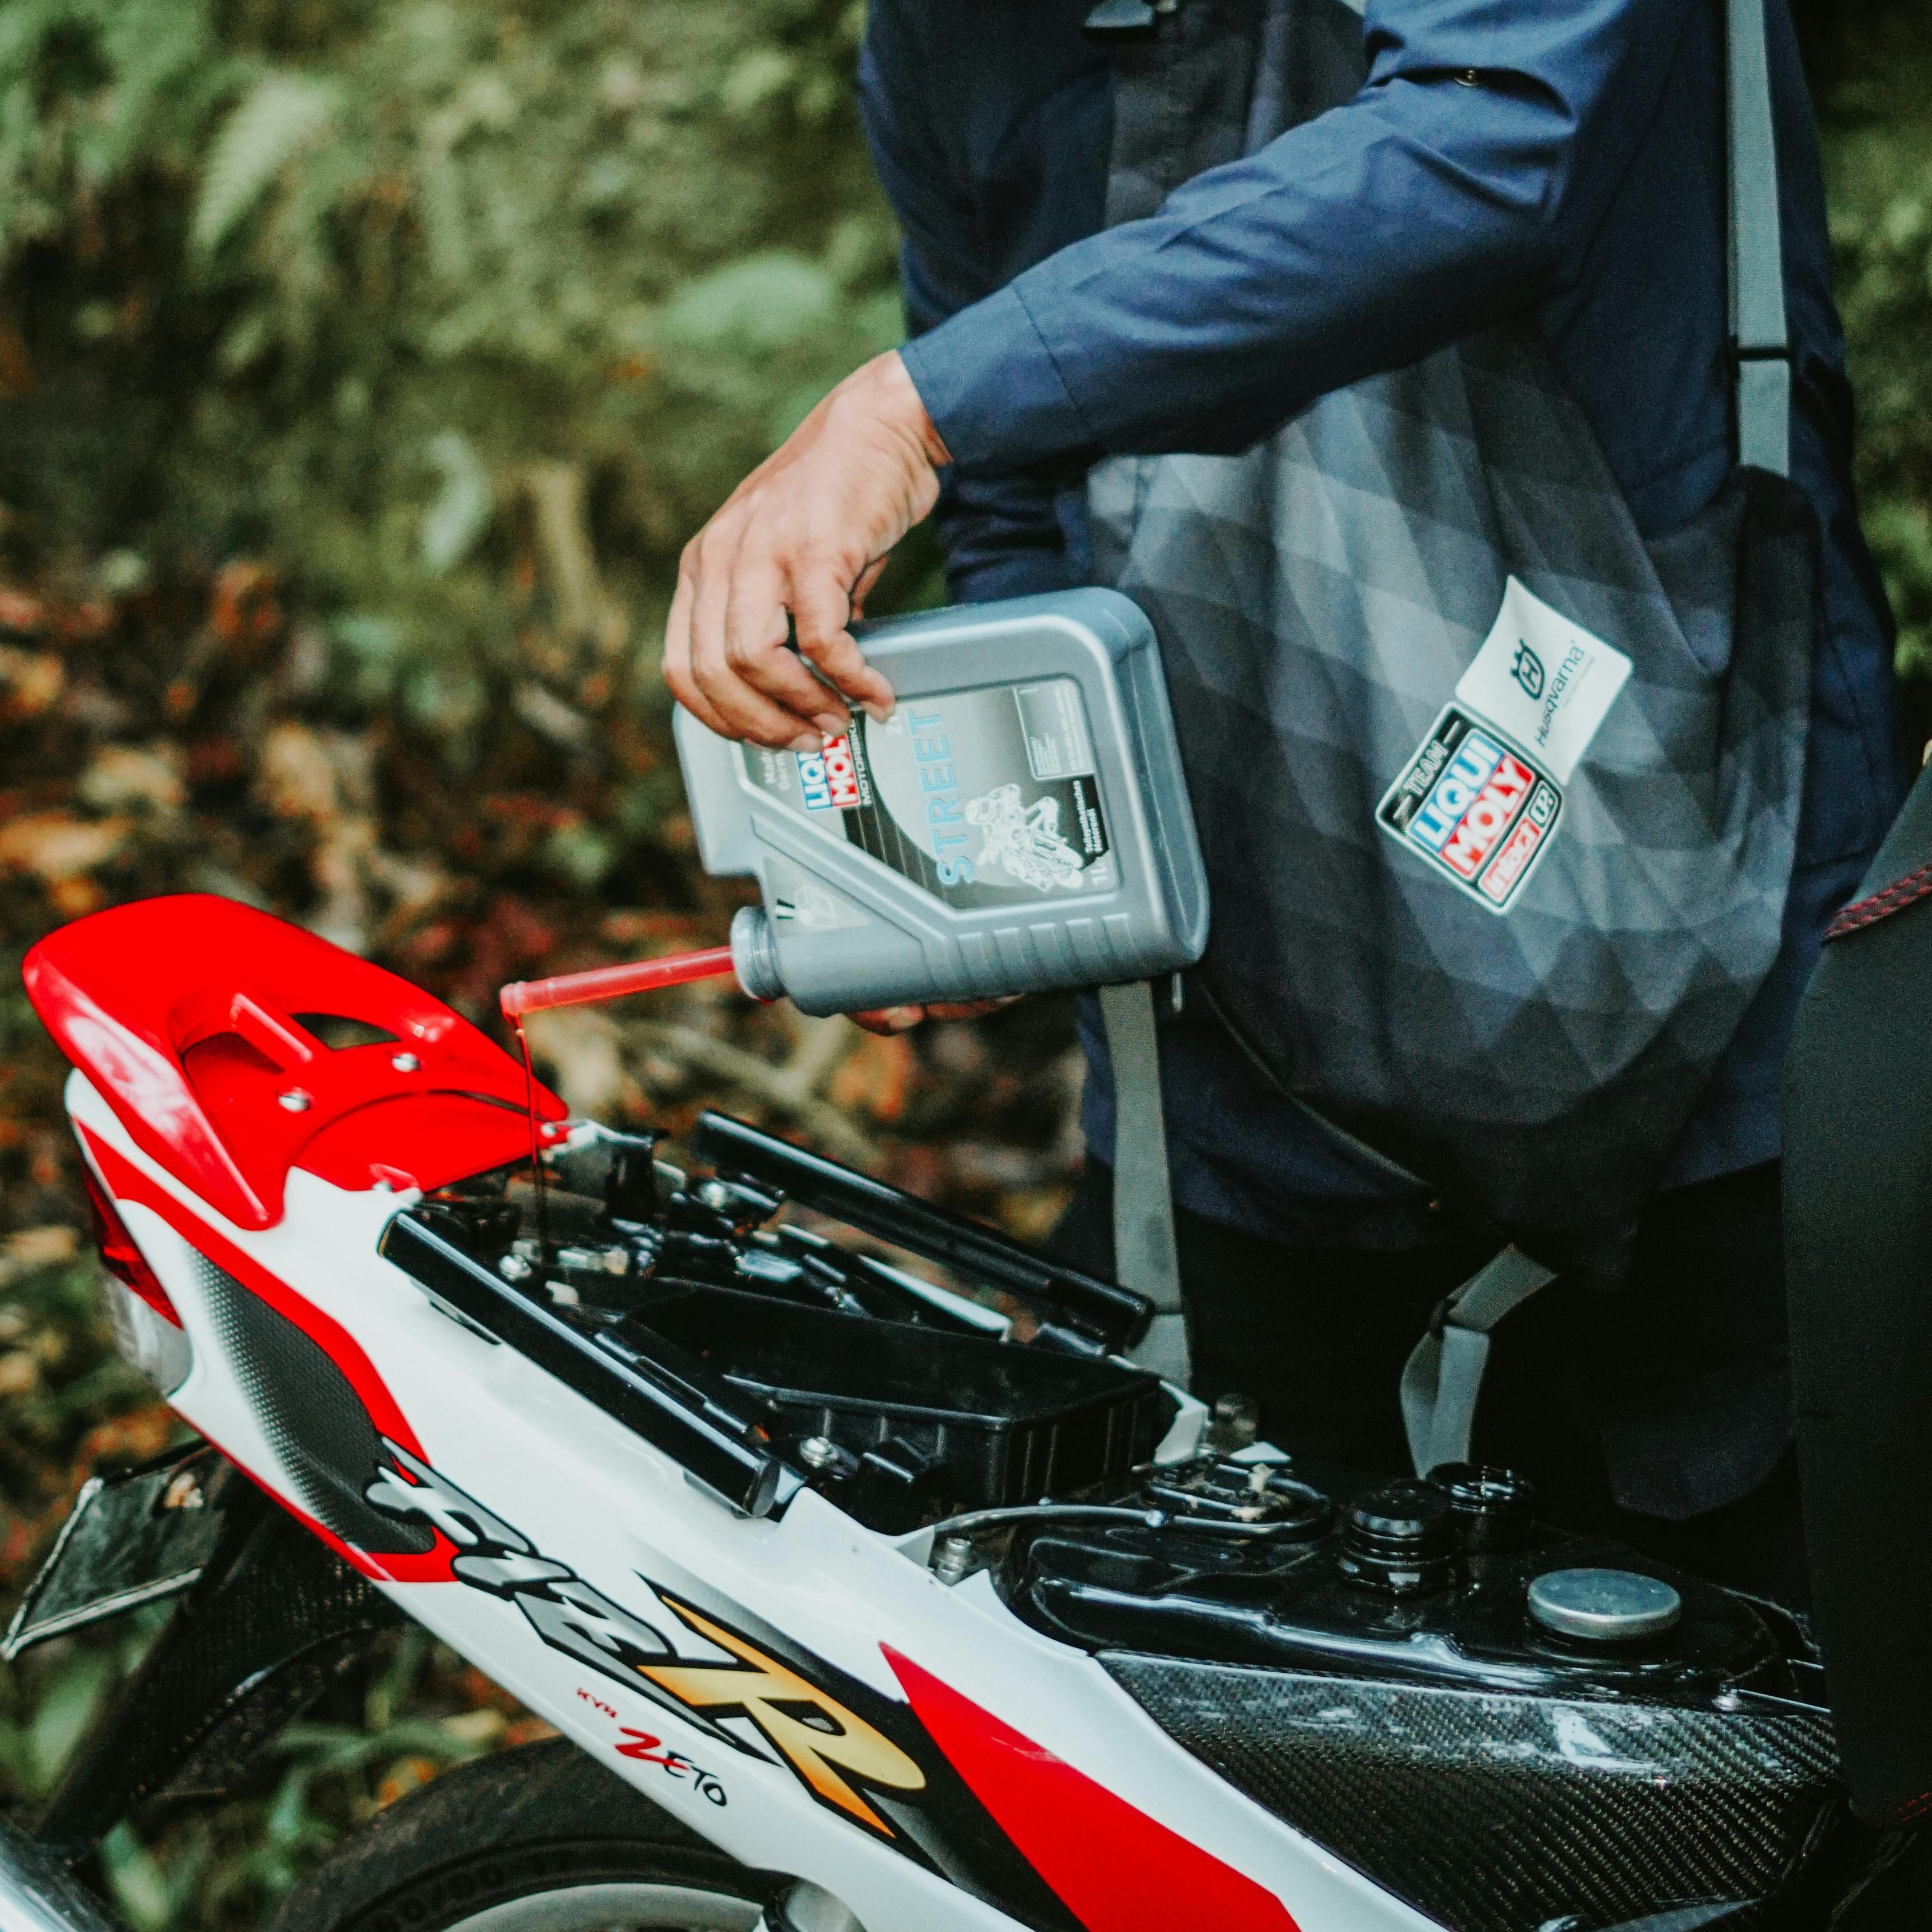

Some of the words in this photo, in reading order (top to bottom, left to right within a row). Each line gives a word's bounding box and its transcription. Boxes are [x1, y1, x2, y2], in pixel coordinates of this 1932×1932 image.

[1534, 646, 1585, 748] Husqvarna
[775, 752, 791, 790] Germ
[907, 710, 973, 885] STREET
[1404, 739, 1448, 797] TEAM
[1413, 737, 1501, 848] LIQUI
[1444, 757, 1528, 871] MOLY
[613, 1726, 728, 1807] ZETO
